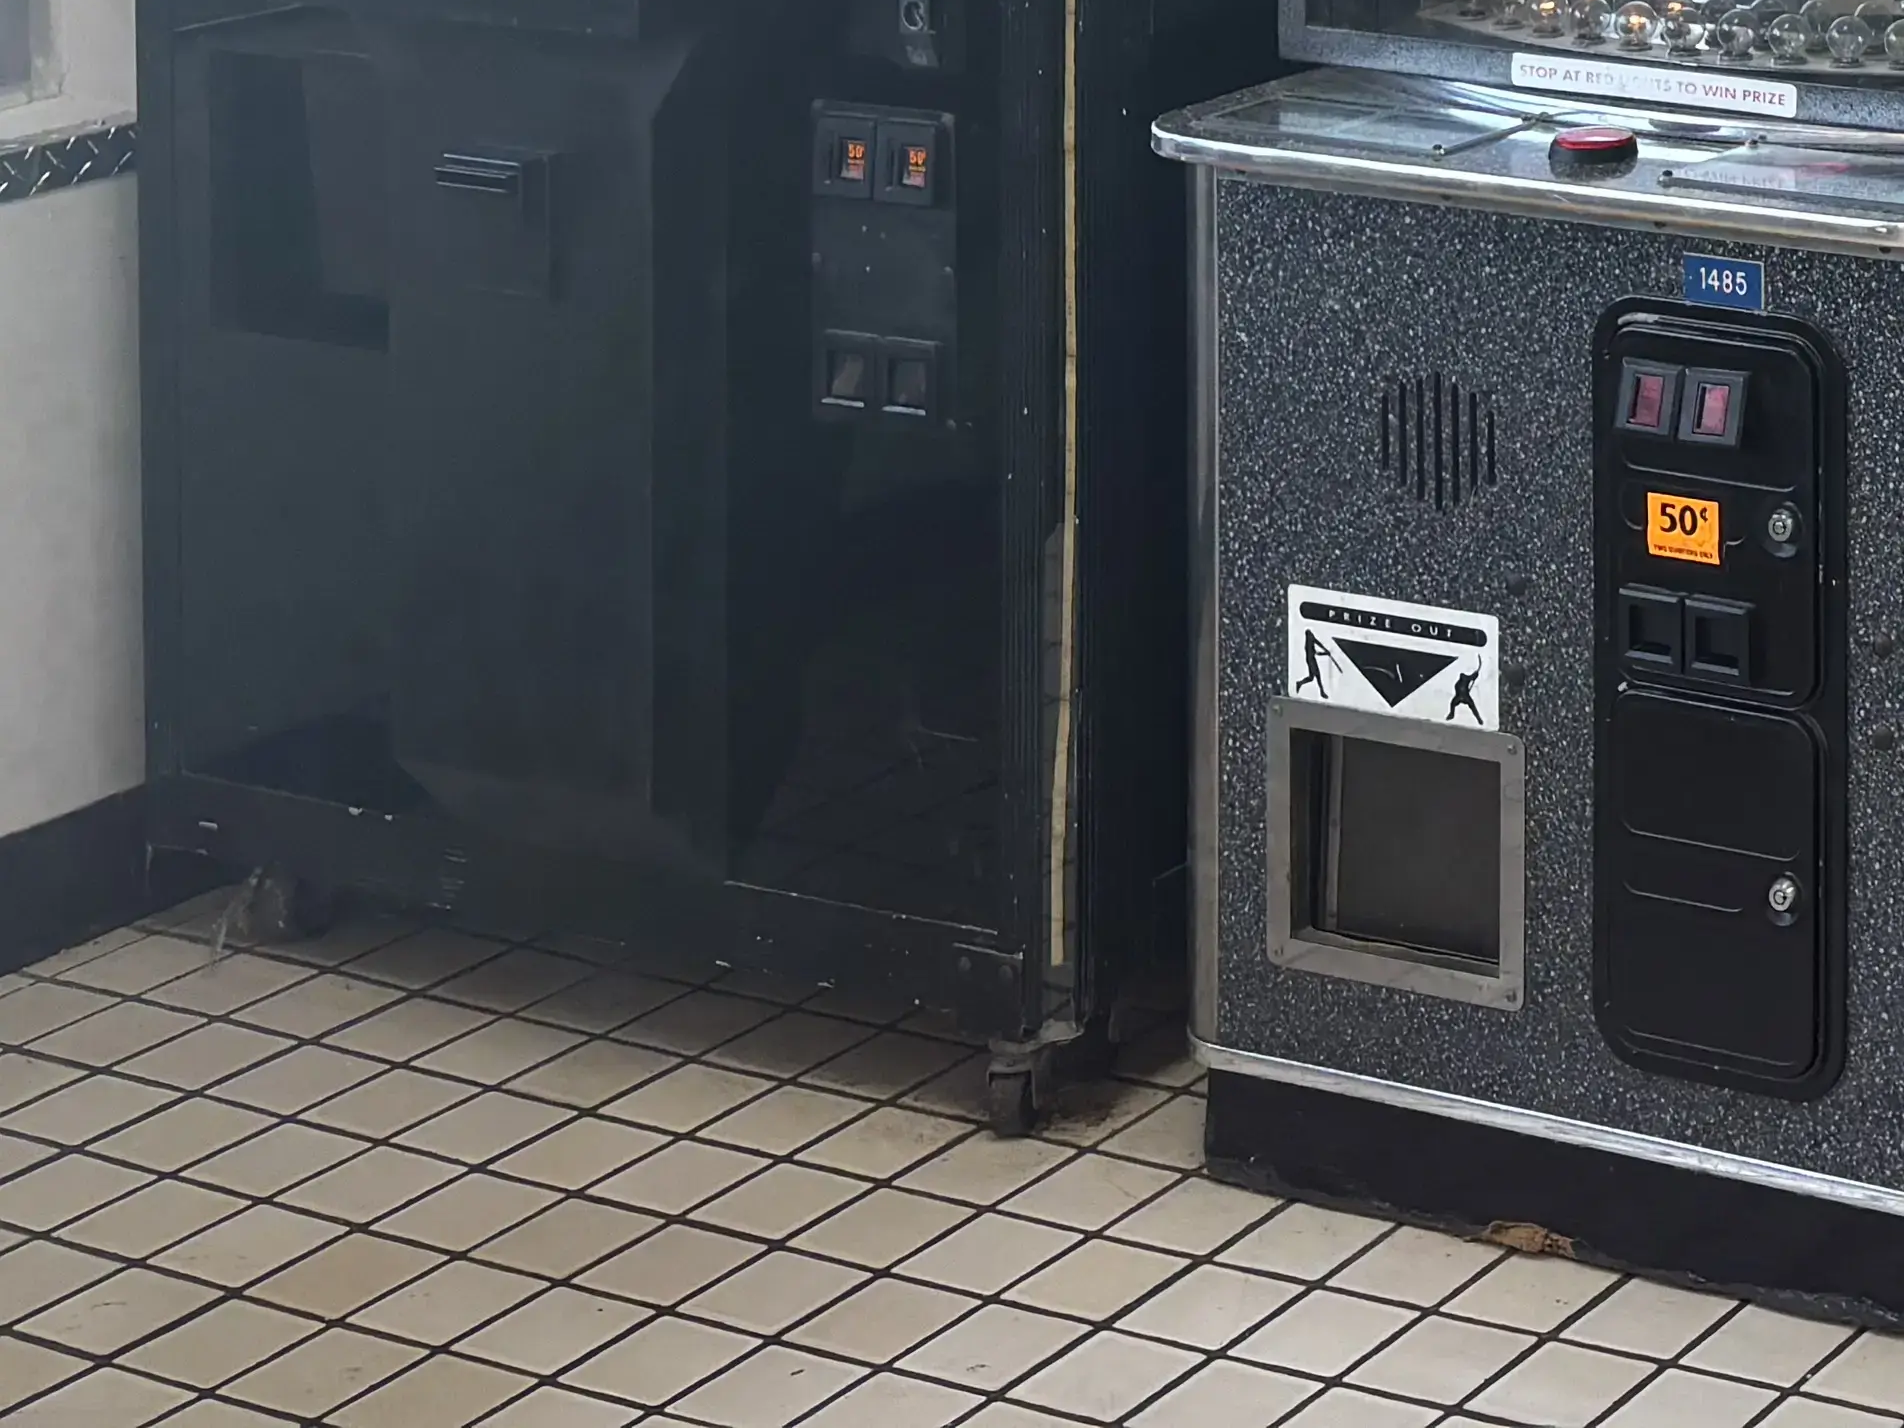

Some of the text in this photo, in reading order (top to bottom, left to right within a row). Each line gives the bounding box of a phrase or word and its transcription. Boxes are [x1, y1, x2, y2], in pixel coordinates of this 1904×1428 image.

[1520, 64, 1557, 80] STOP
[1563, 69, 1580, 82] AT
[1676, 80, 1698, 94] TO
[1702, 84, 1737, 99] WIN
[1742, 89, 1786, 106] PRIZE
[1699, 266, 1748, 296] 1485
[1660, 501, 1709, 536] 50¢
[1329, 609, 1453, 638] PRIZE OUT
